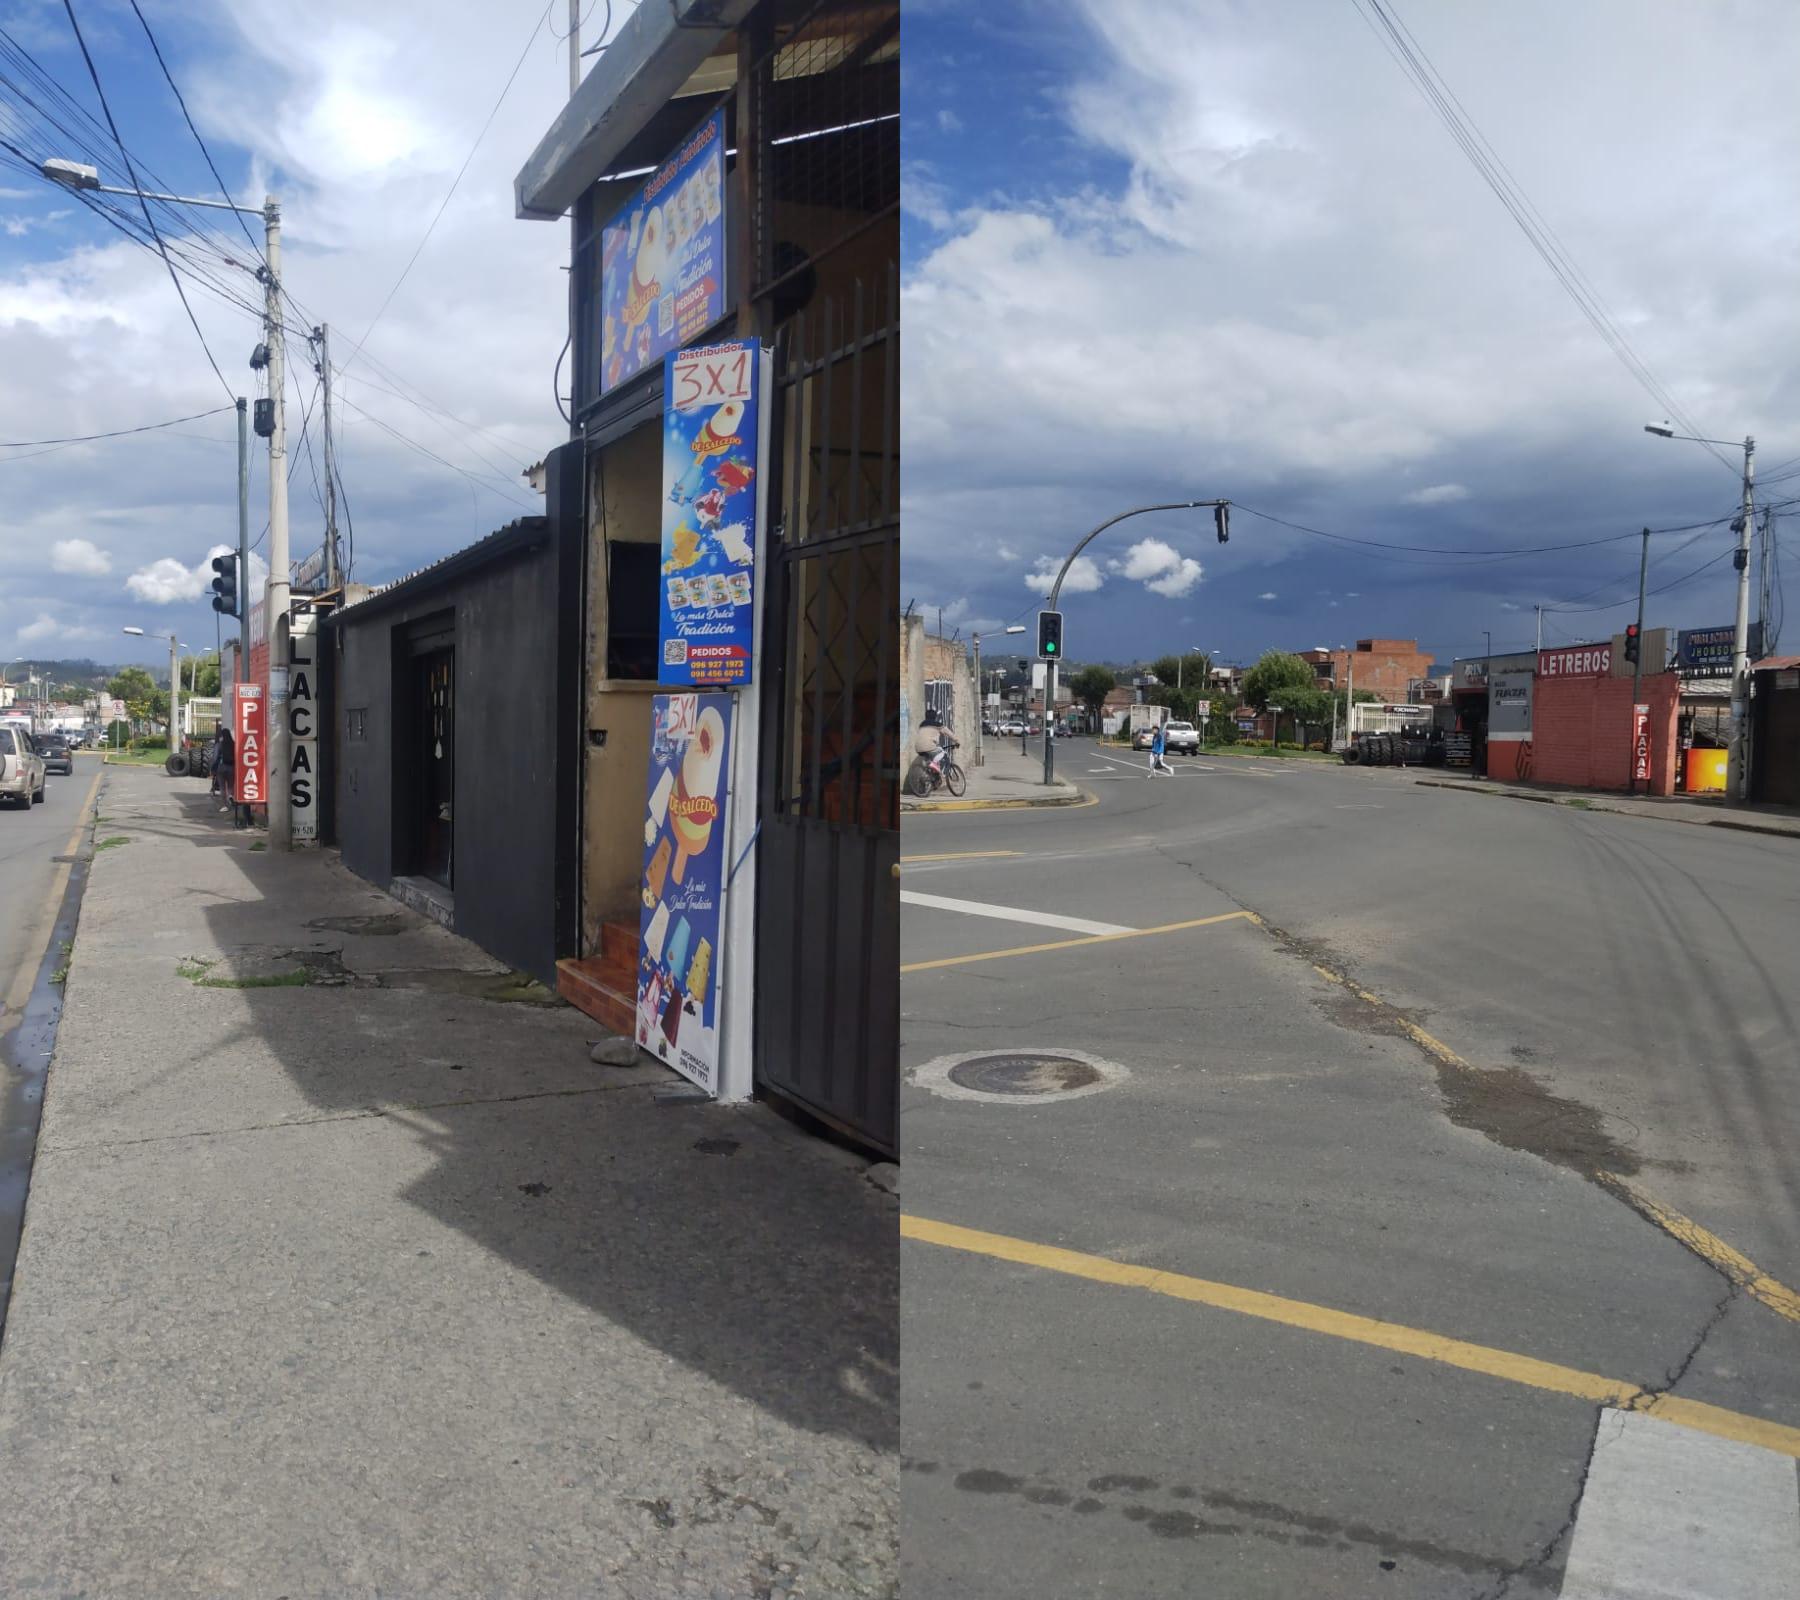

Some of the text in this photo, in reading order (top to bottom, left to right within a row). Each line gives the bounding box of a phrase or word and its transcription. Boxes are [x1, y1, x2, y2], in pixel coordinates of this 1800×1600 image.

[676, 283, 705, 314] PEDIDOS
[679, 343, 743, 361] Distribuidor
[674, 352, 748, 408] 3X1
[706, 608, 735, 621] Dulce
[675, 622, 736, 637] Tradición
[691, 647, 732, 657] PEDIDOS
[1541, 650, 1610, 676] LETREROS
[290, 599, 312, 808] PLACAS
[242, 702, 259, 800] PLACAS
[1637, 715, 1648, 779] PLACAS
[681, 798, 717, 818] SALCEDO
